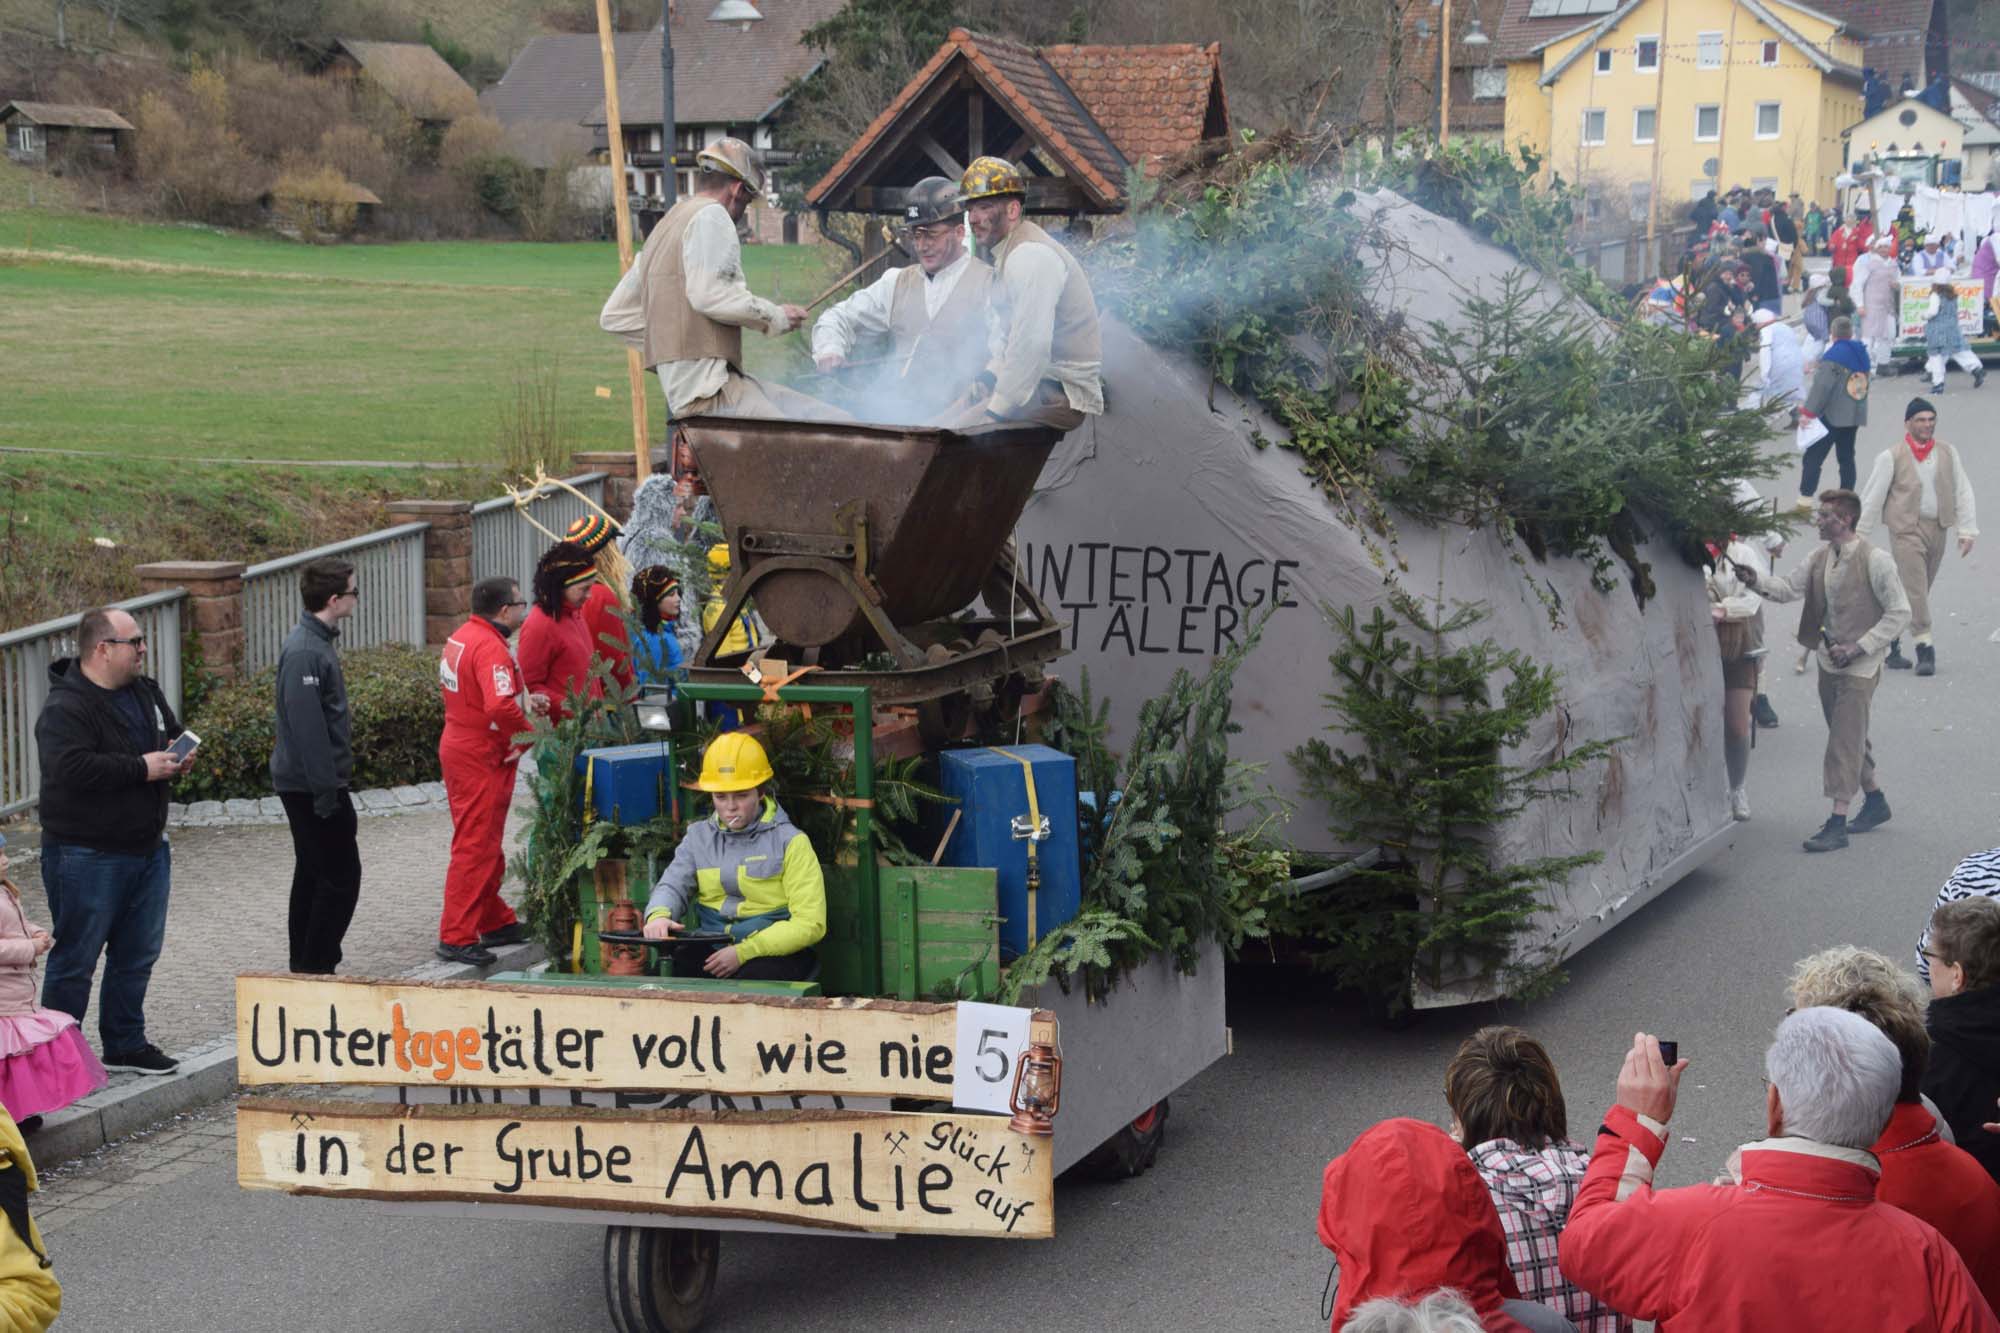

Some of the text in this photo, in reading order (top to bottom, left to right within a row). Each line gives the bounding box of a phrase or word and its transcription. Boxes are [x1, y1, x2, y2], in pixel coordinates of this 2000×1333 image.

[1060, 601, 1240, 656] TÄLER
[251, 1003, 954, 1085] Untertagetäler voll wie nie
[974, 1028, 1010, 1083] 5
[294, 1121, 954, 1214] in der Grube Amalie
[924, 1120, 1011, 1184] Glück
[975, 1184, 1035, 1233] auf
